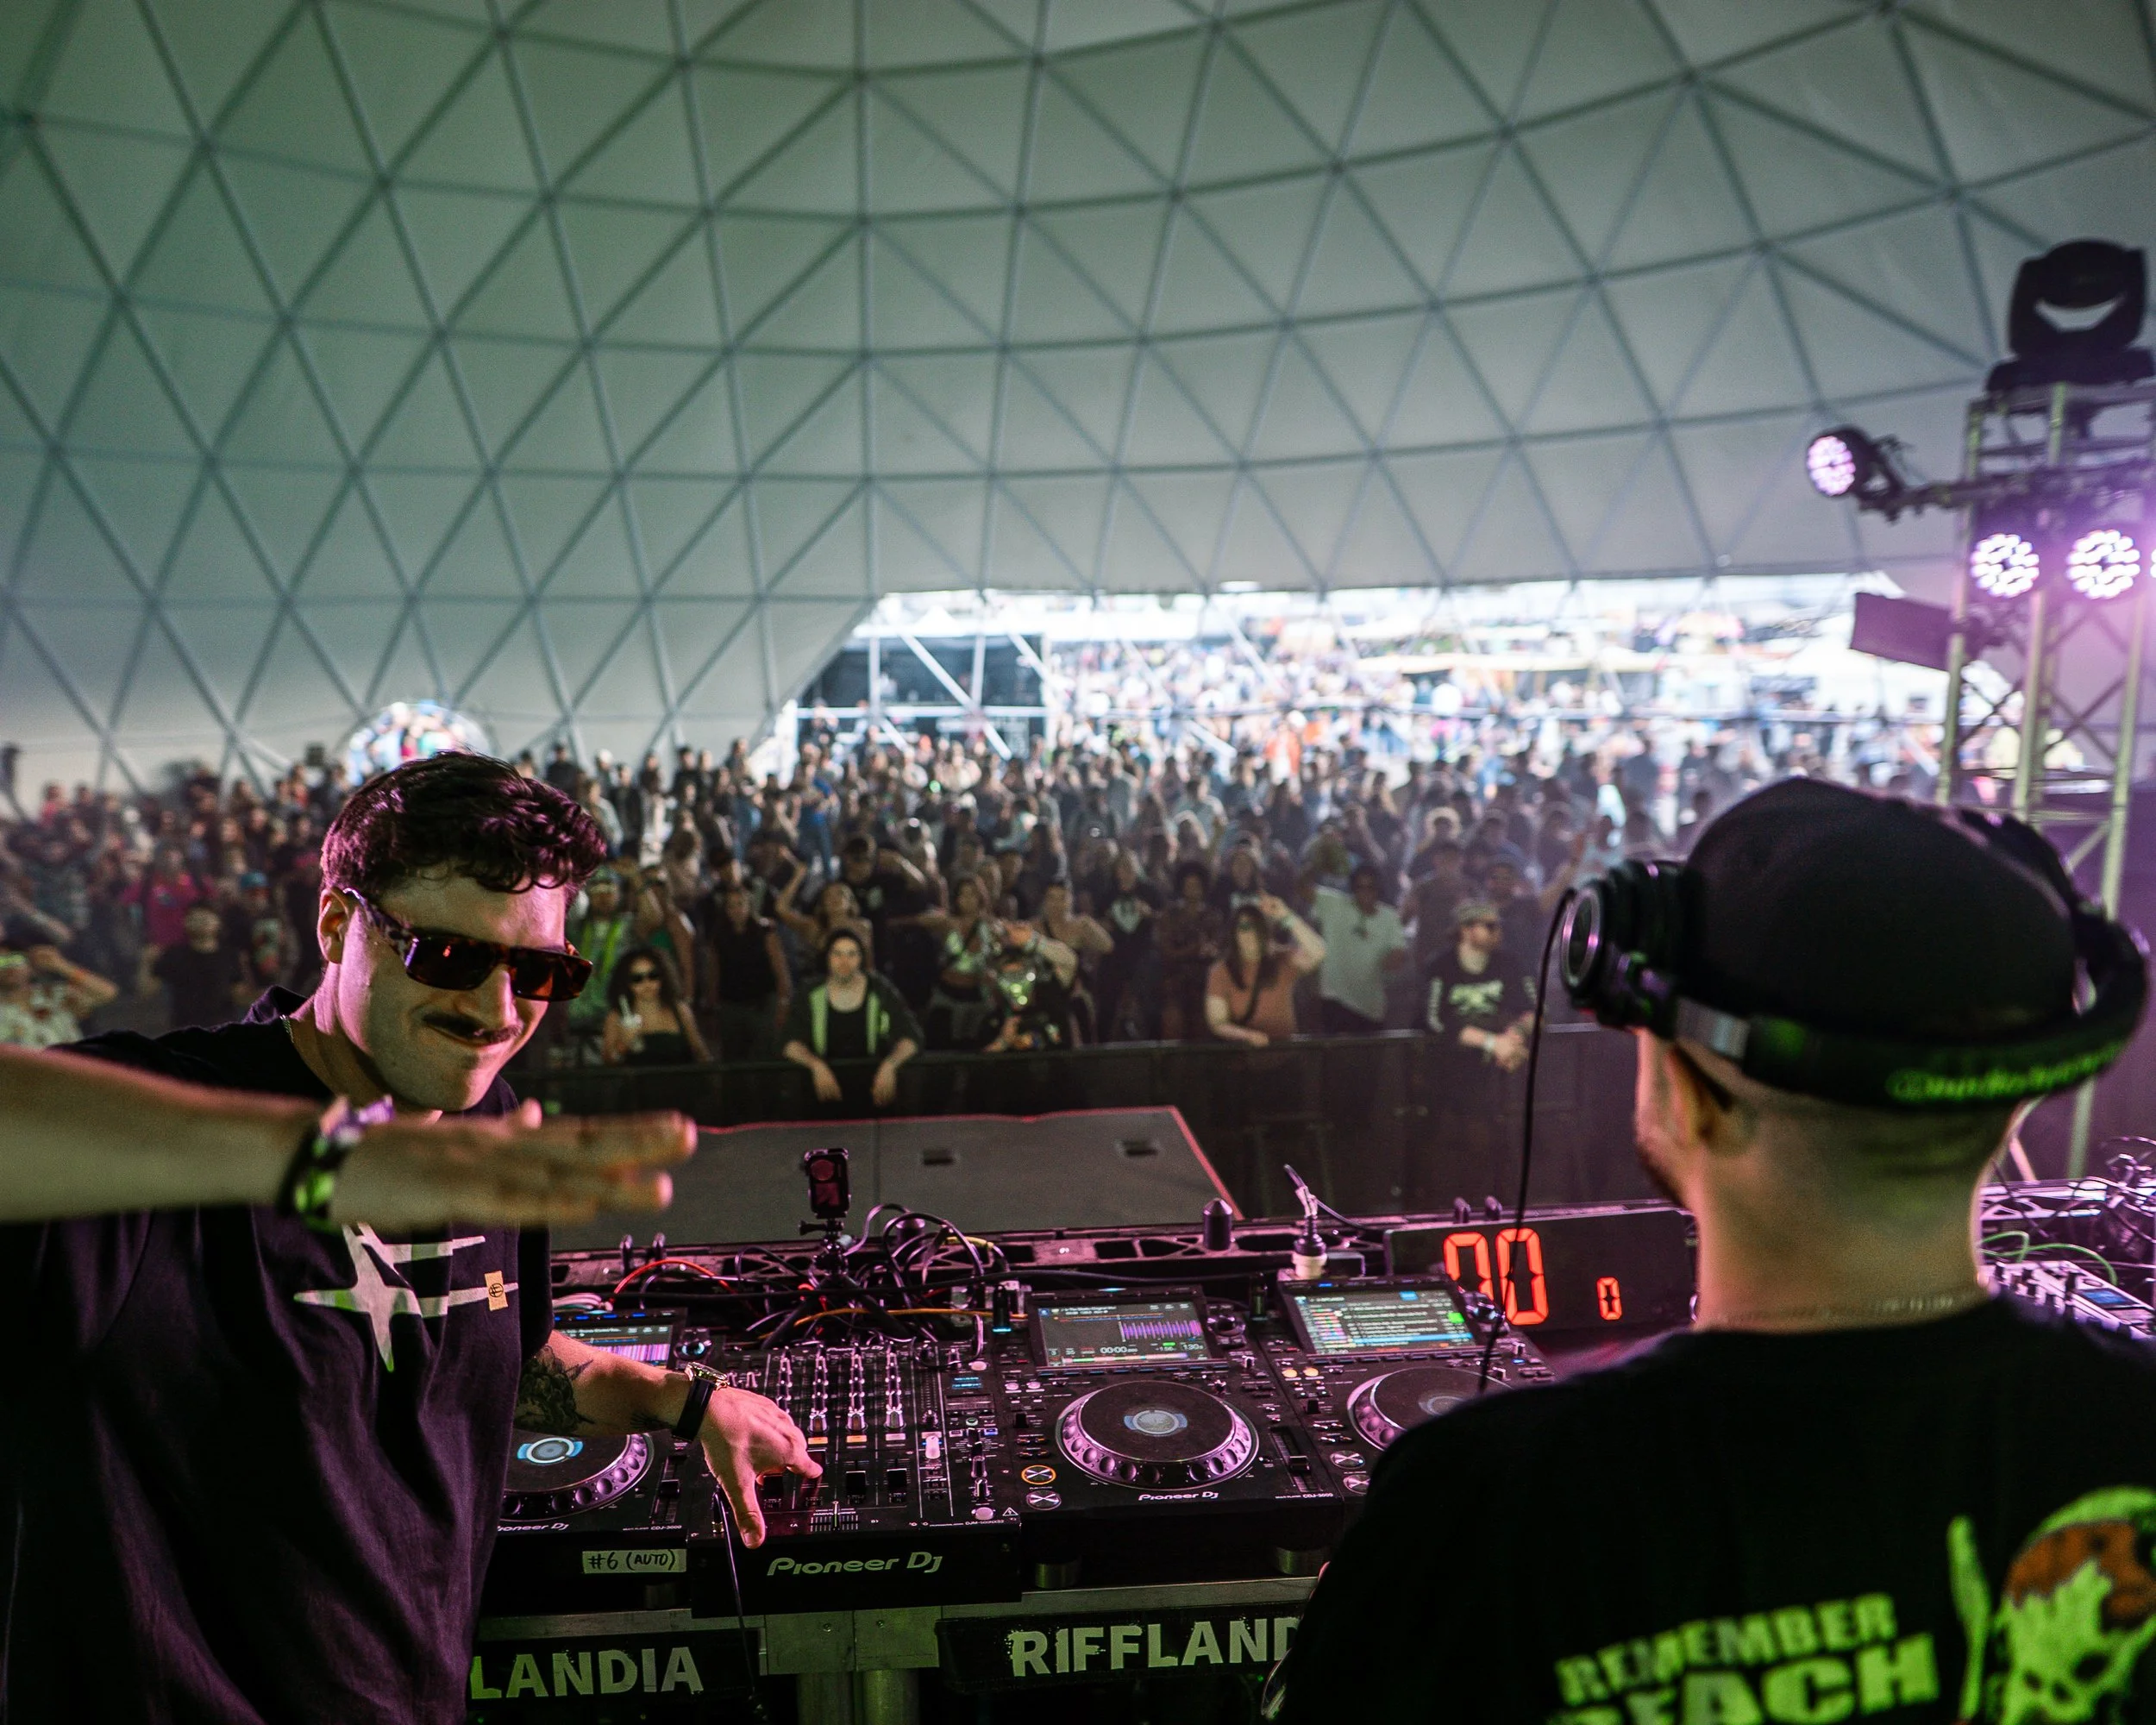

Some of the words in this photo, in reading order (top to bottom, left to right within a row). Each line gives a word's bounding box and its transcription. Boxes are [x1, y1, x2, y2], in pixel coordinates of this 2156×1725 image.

[1596, 1276, 1622, 1321] 0
[589, 1552, 618, 1571] #6
[626, 1549, 676, 1571] (AUTO)
[767, 1558, 899, 1576] Pioneer
[1555, 1591, 1896, 1706] REMEMBER
[470, 1647, 704, 1699] LANDIA
[1547, 1632, 1940, 1725] EACH
